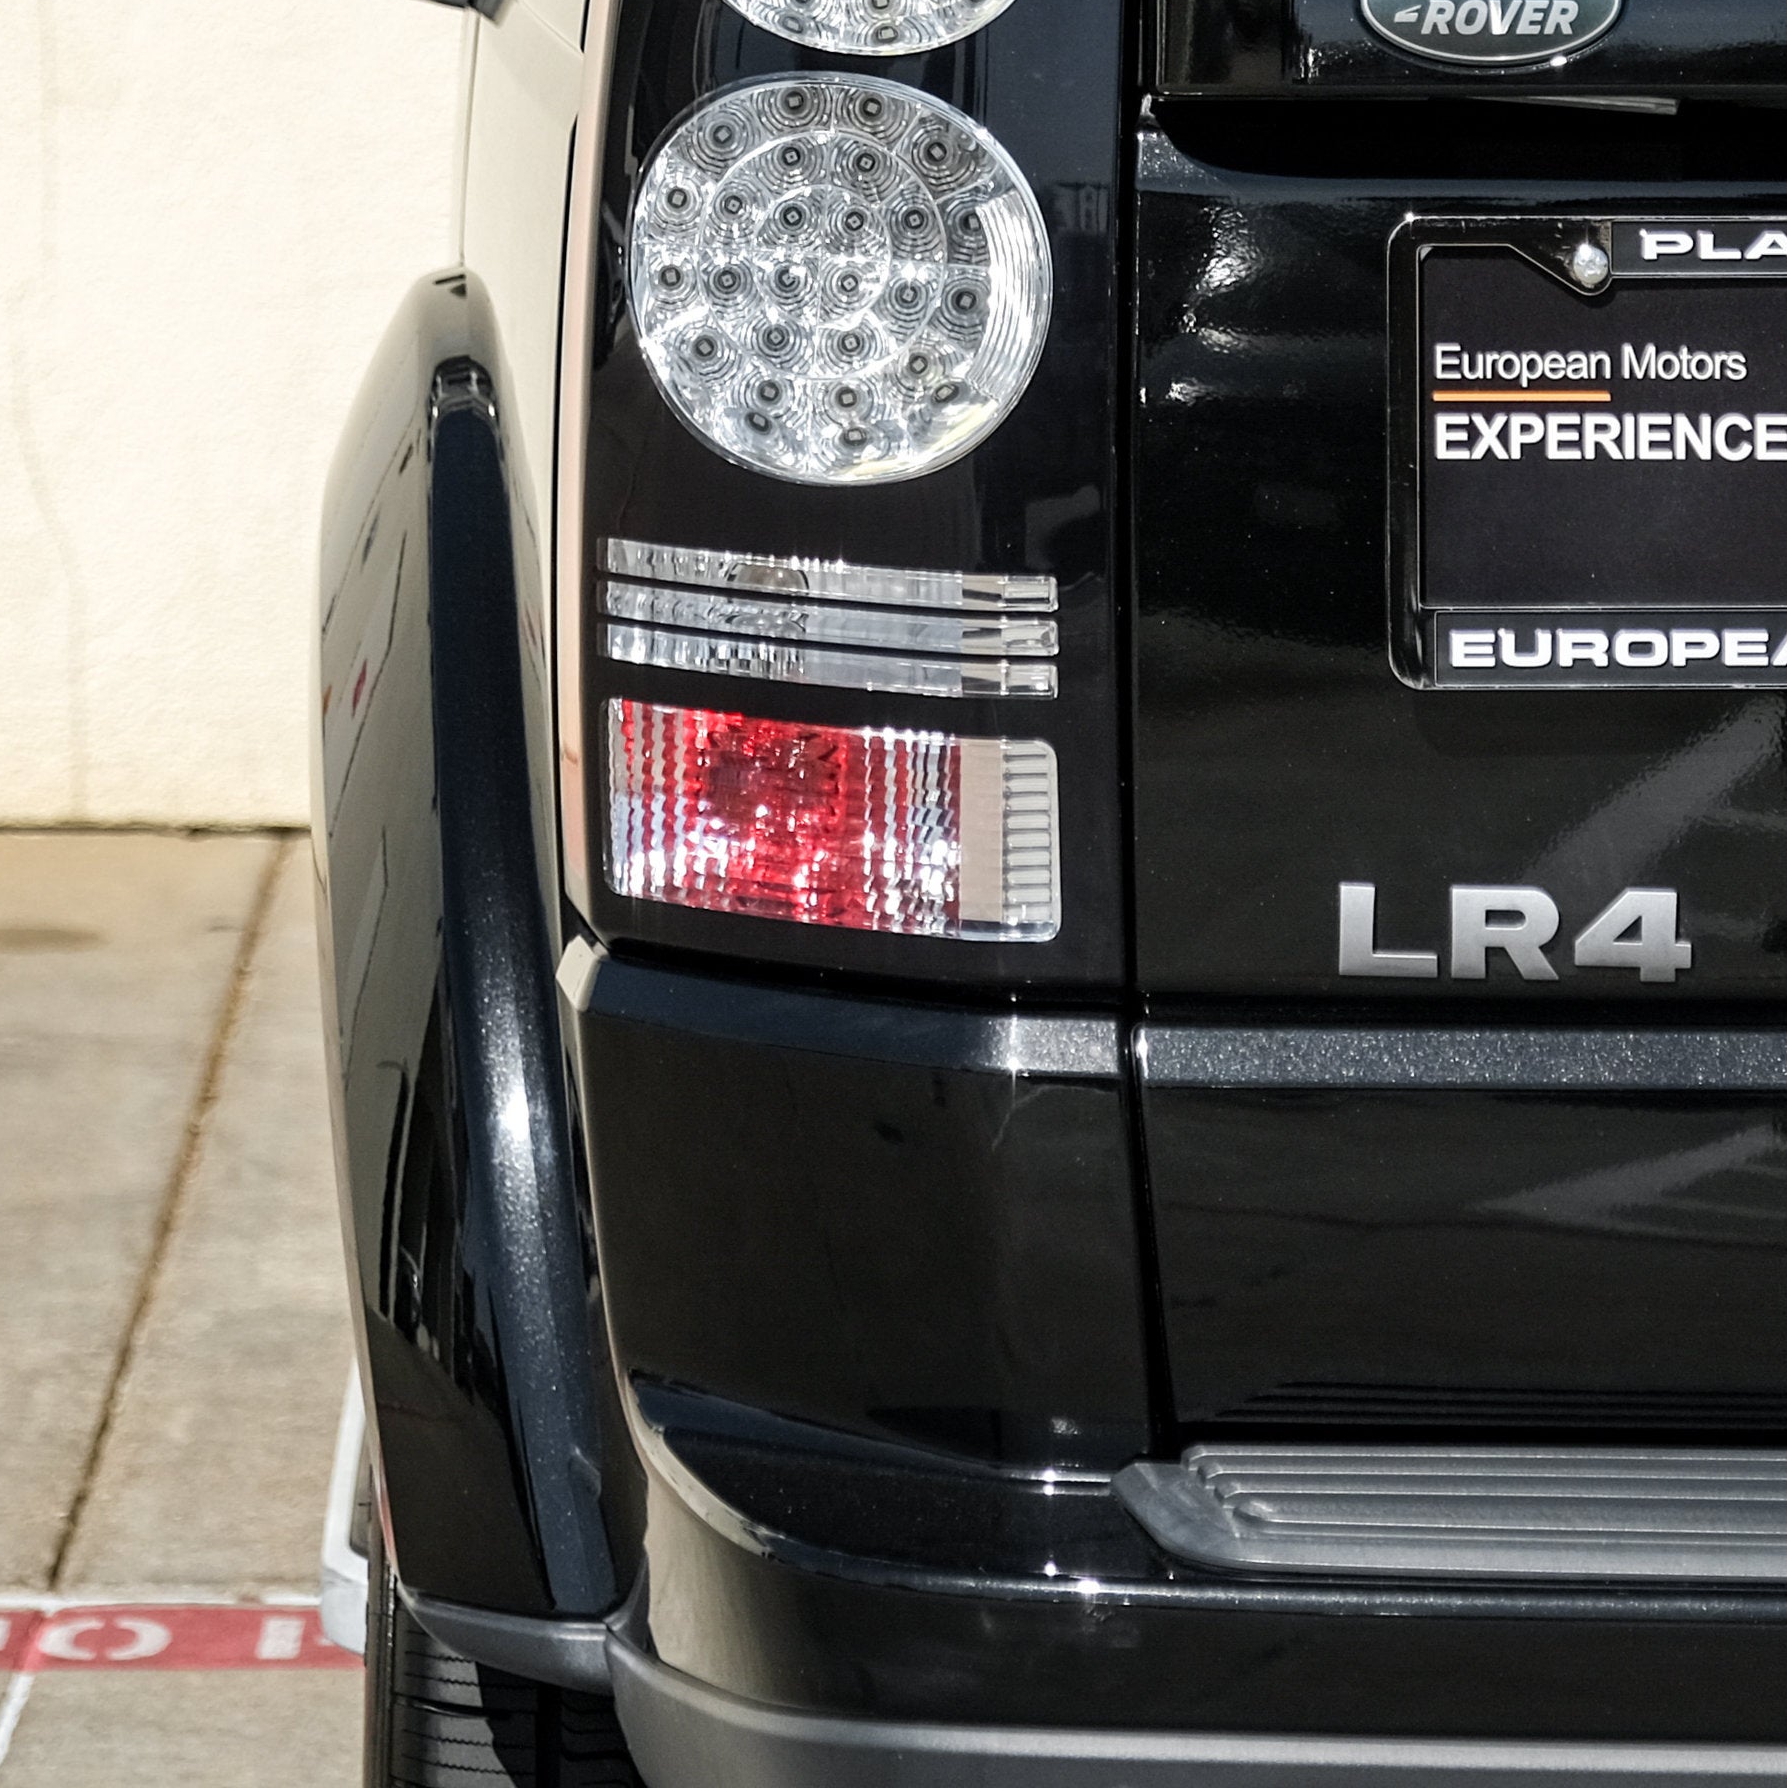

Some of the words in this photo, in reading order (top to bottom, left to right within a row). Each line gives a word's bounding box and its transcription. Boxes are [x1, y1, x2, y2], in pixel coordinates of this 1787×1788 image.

[1434, 342, 1611, 388] European
[1621, 342, 1747, 381] Motors
[1338, 881, 1692, 982] LR4
